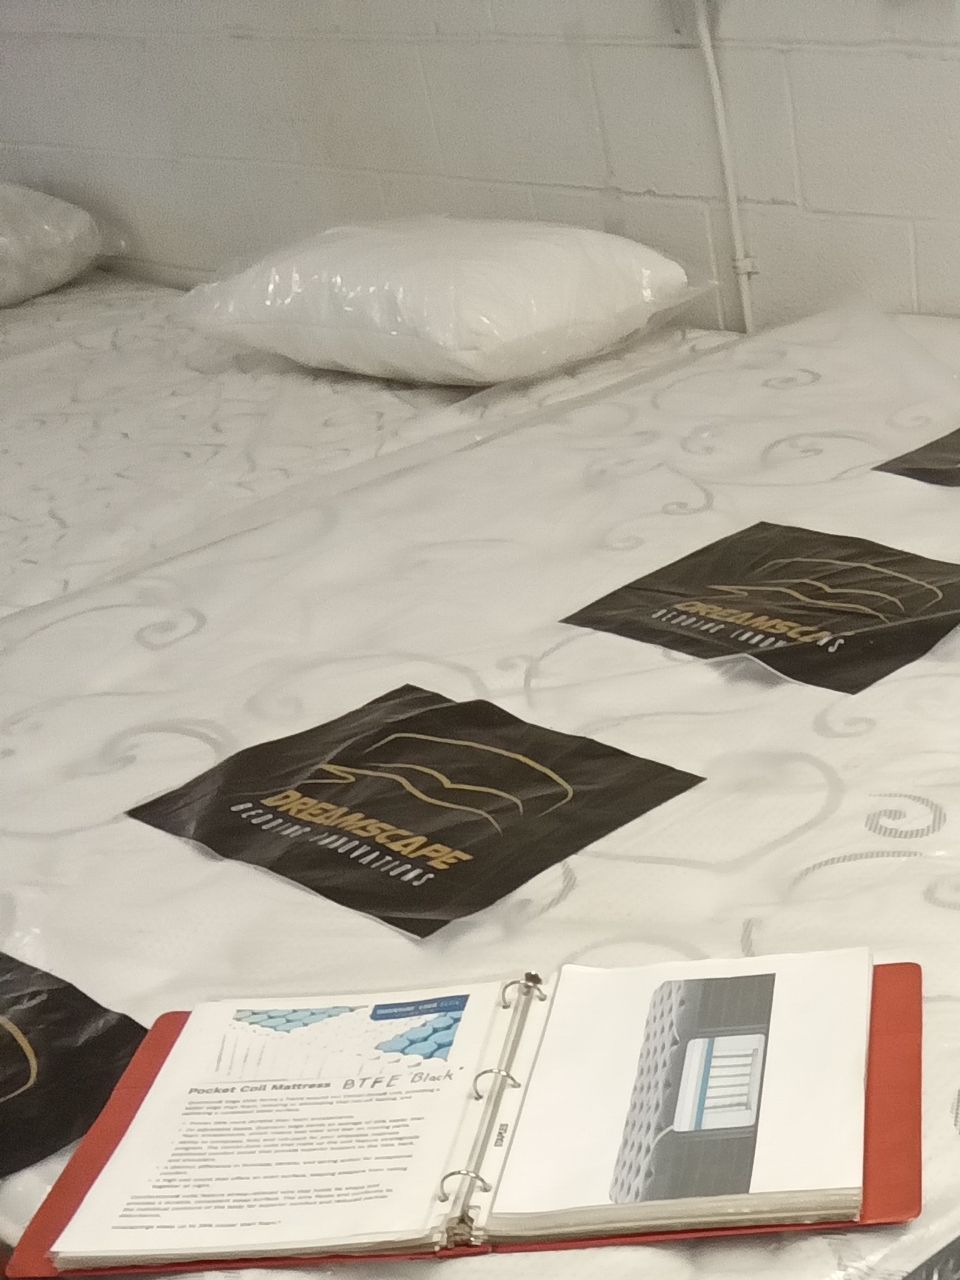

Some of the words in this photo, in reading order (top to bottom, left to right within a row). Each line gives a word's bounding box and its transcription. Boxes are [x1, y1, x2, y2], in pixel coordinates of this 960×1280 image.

[230, 802, 312, 838] BEDDING
[309, 832, 435, 887] INNOVATIONS
[260, 789, 474, 870] DREAMSCAPE
[188, 1087, 237, 1095] Pocket
[240, 1084, 268, 1093] Coil
[271, 1082, 331, 1091] Mattress
